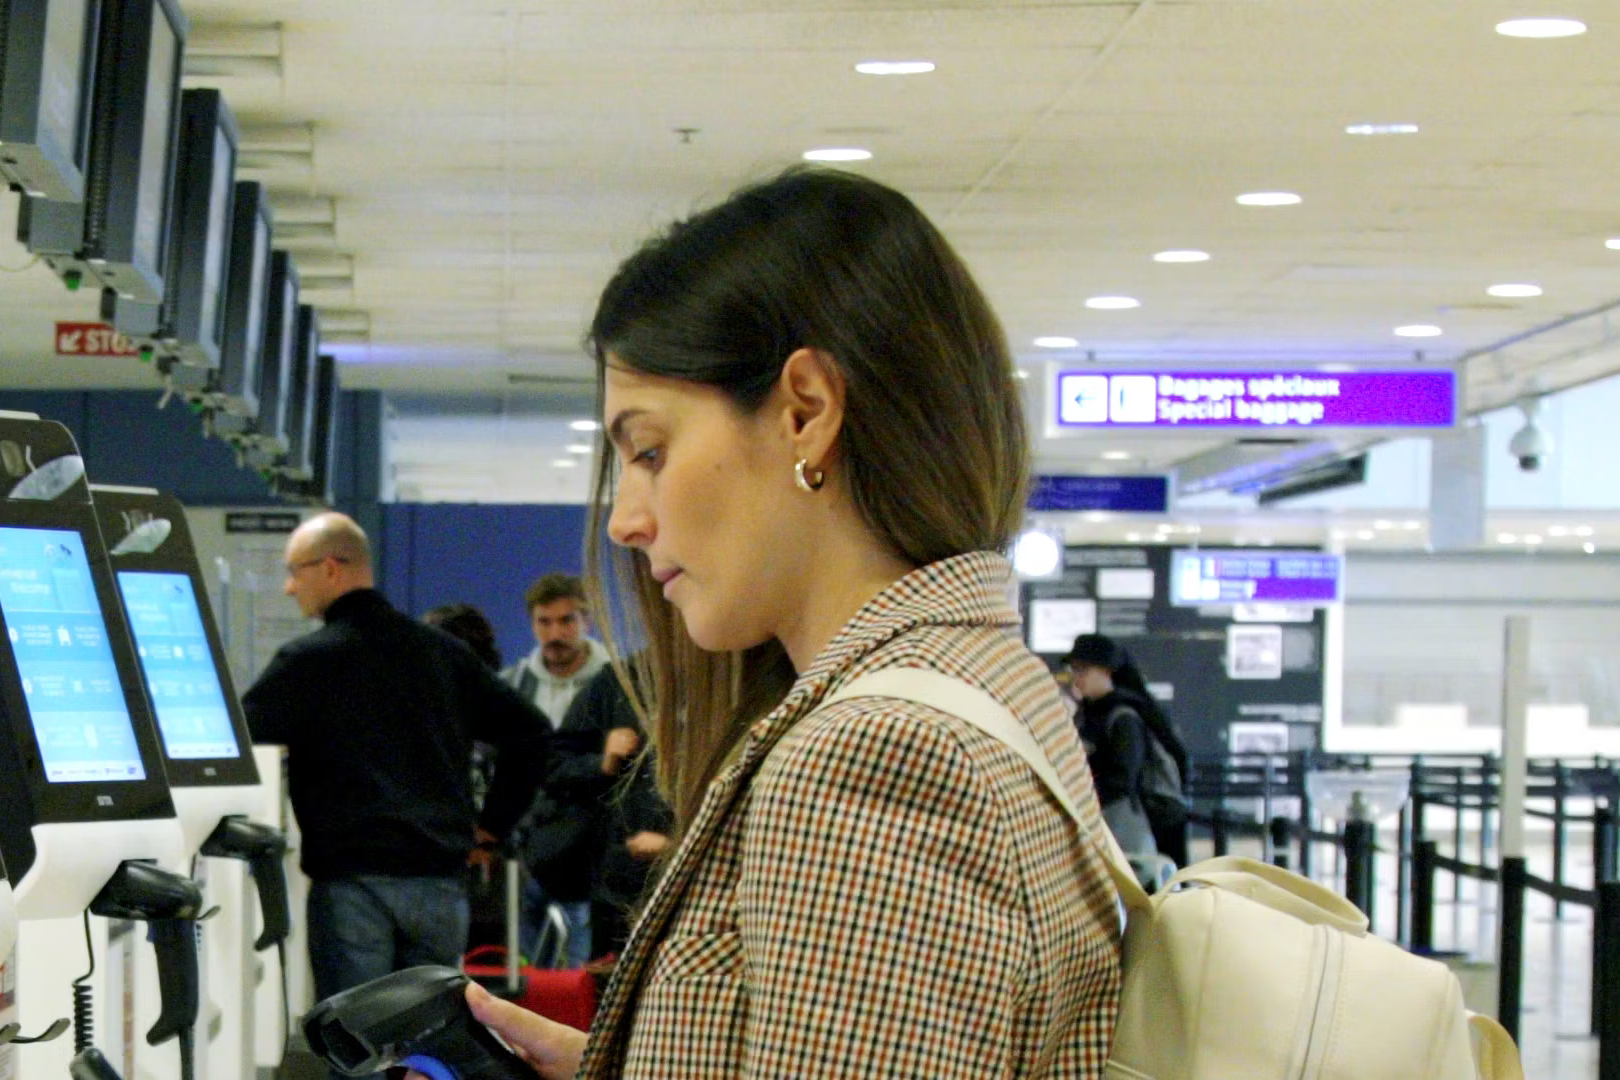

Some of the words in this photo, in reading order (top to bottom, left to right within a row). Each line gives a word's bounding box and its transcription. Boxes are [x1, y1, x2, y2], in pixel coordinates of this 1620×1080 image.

[85, 329, 134, 353] STO
[1158, 374, 1245, 401] Bagages
[1158, 398, 1232, 424] Special
[1234, 398, 1325, 424] baggage
